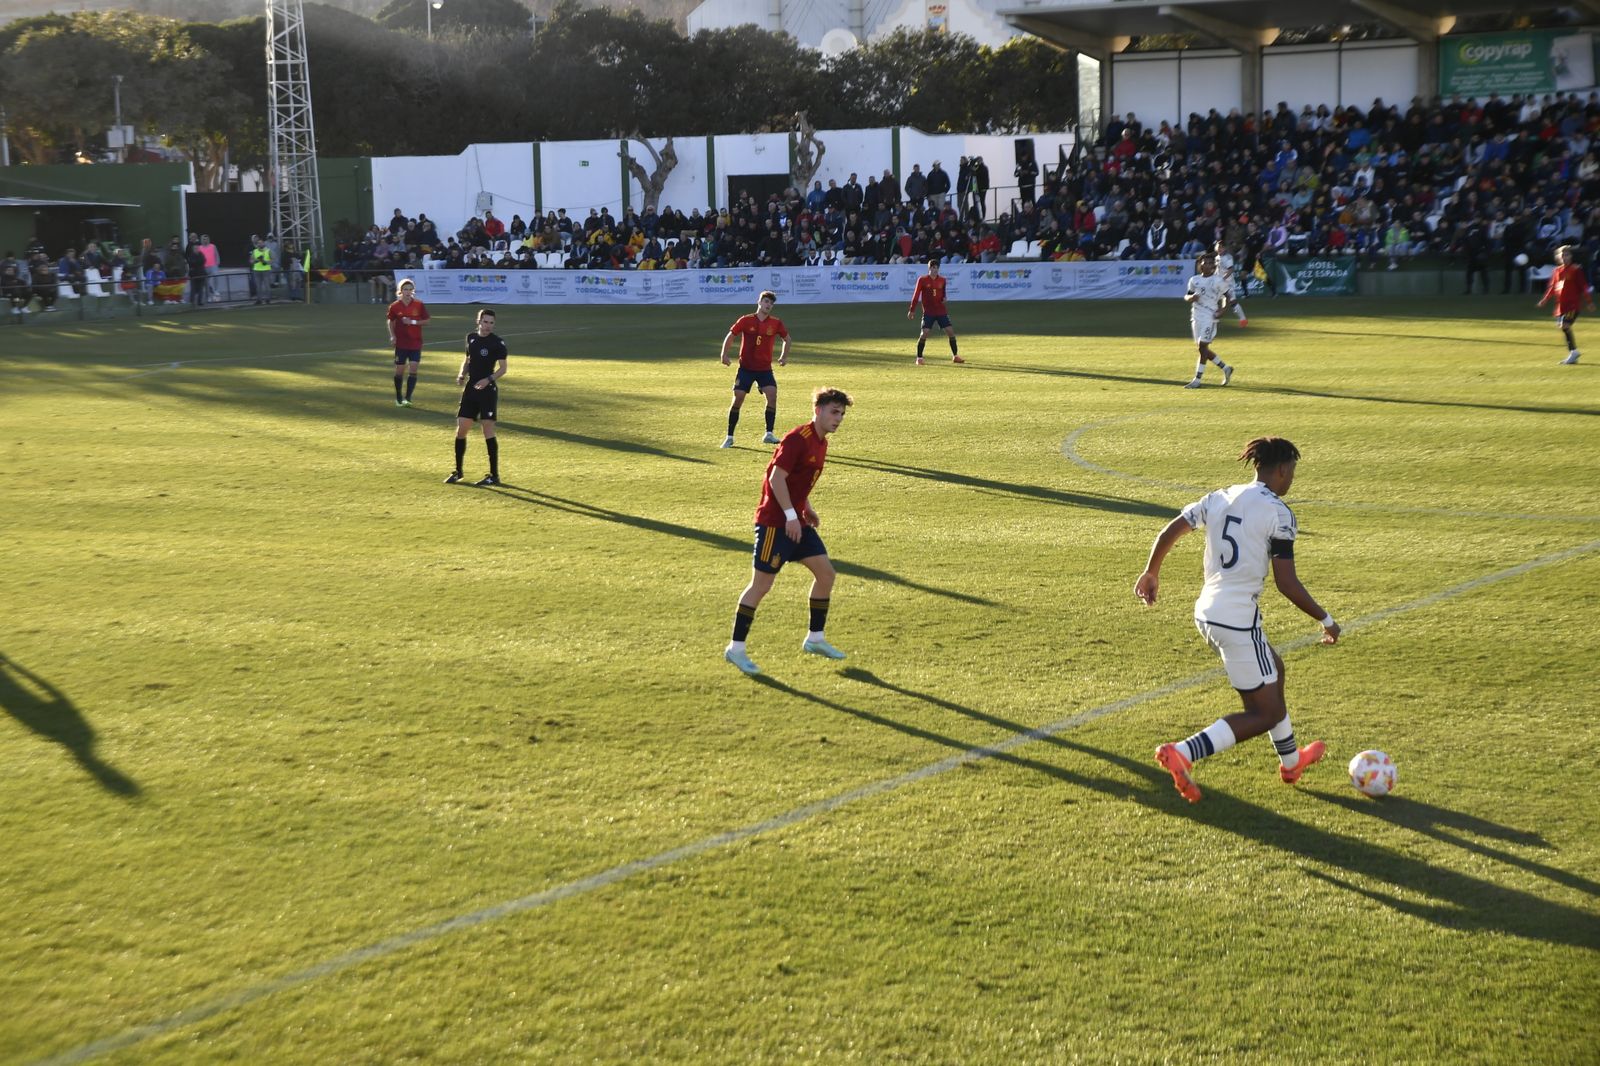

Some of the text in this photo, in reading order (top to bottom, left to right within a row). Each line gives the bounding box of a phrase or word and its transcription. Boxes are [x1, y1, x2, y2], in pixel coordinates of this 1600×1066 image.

[1308, 261, 1337, 269] HOTEL
[1297, 269, 1348, 278] PEZ ESPADA
[756, 335, 762, 346] 6
[1220, 514, 1242, 569] 5
